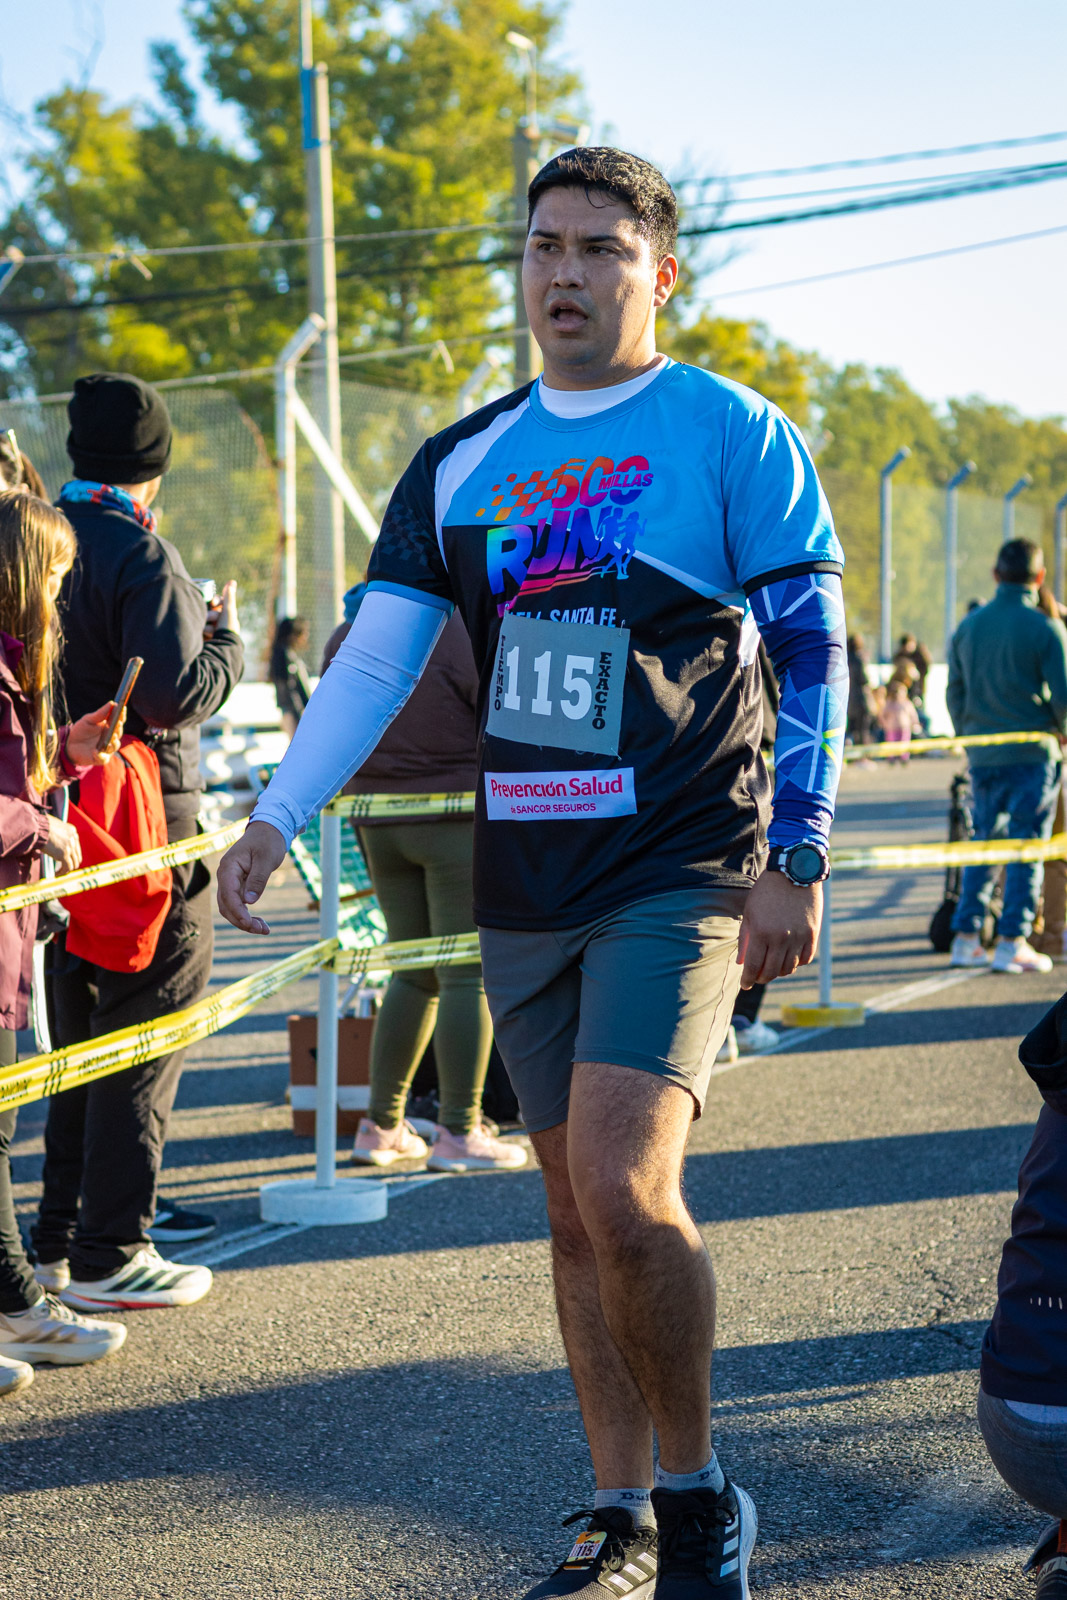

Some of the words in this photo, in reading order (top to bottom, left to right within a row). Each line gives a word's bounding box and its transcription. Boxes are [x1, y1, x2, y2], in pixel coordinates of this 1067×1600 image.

[599, 473, 655, 492] MILLAS
[487, 505, 614, 596] RUN
[549, 607, 595, 625] SANTA
[600, 608, 617, 628] FE
[494, 634, 506, 711] TIEMPO
[503, 646, 595, 720] 115
[591, 651, 612, 730] EXACTO
[569, 774, 623, 797] Salud
[516, 804, 552, 814] SANCOR
[552, 803, 597, 813] SEGUROS
[576, 1545, 594, 1557] 115
